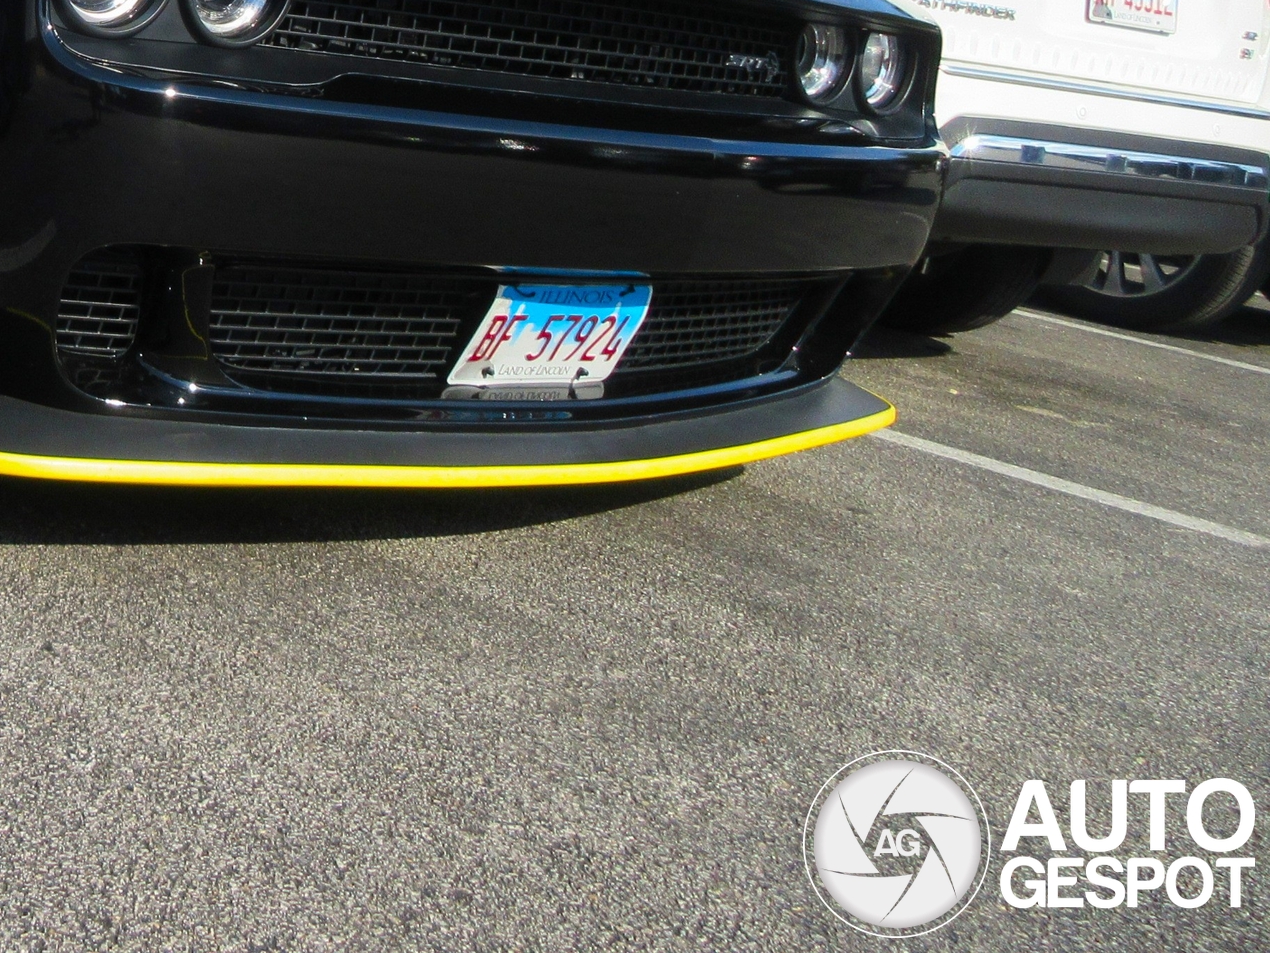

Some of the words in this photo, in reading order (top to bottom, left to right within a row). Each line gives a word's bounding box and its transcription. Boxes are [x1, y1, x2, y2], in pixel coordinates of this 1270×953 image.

[538, 289, 616, 304] ILLINOIS
[467, 314, 529, 362] BF
[525, 314, 631, 362] 57924
[498, 364, 523, 376] LAND
[524, 365, 536, 375] OF
[536, 364, 570, 376] LINCOLN
